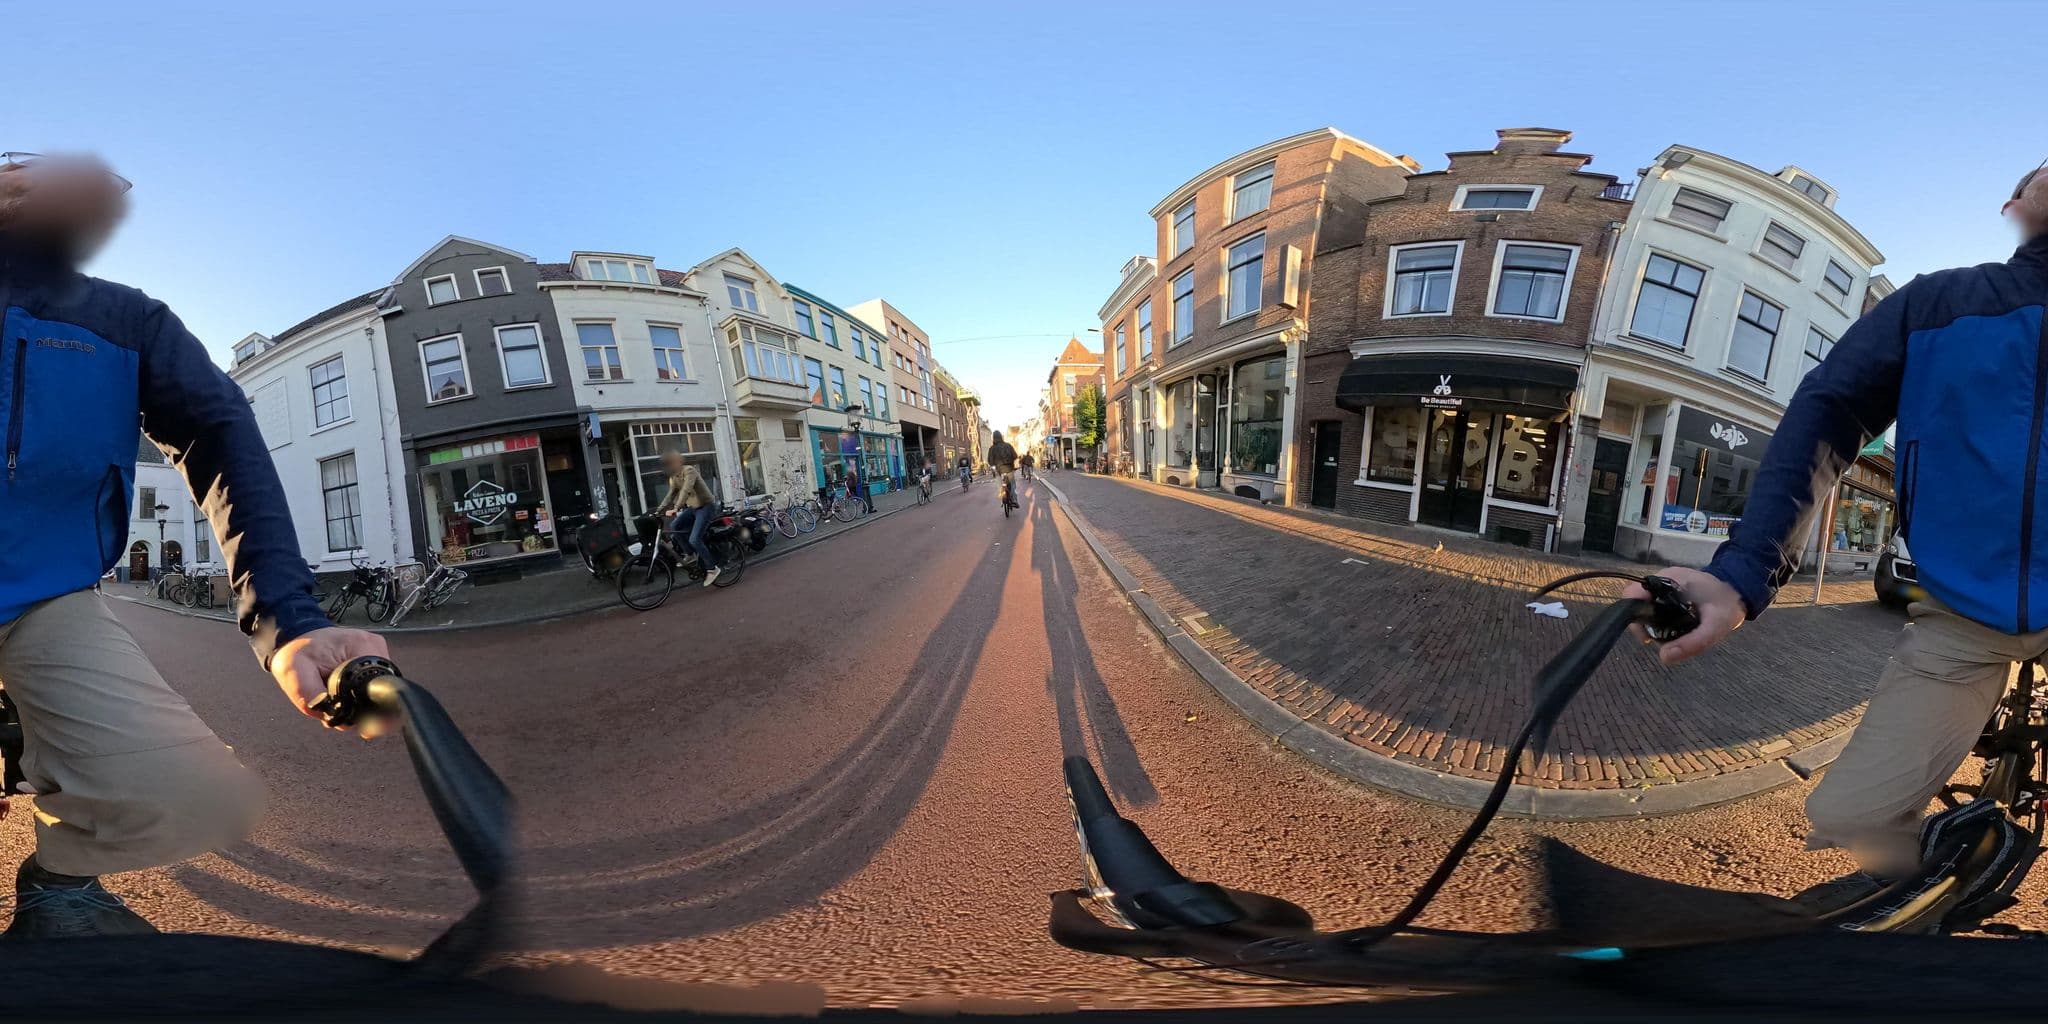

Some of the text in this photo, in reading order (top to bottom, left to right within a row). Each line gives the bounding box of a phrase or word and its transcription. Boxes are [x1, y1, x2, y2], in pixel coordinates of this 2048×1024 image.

[1431, 397, 1462, 406] Beautiful
[453, 492, 518, 512] LAVENO
[1708, 520, 1729, 529] HOLL
[1707, 527, 1729, 536] NIEU
